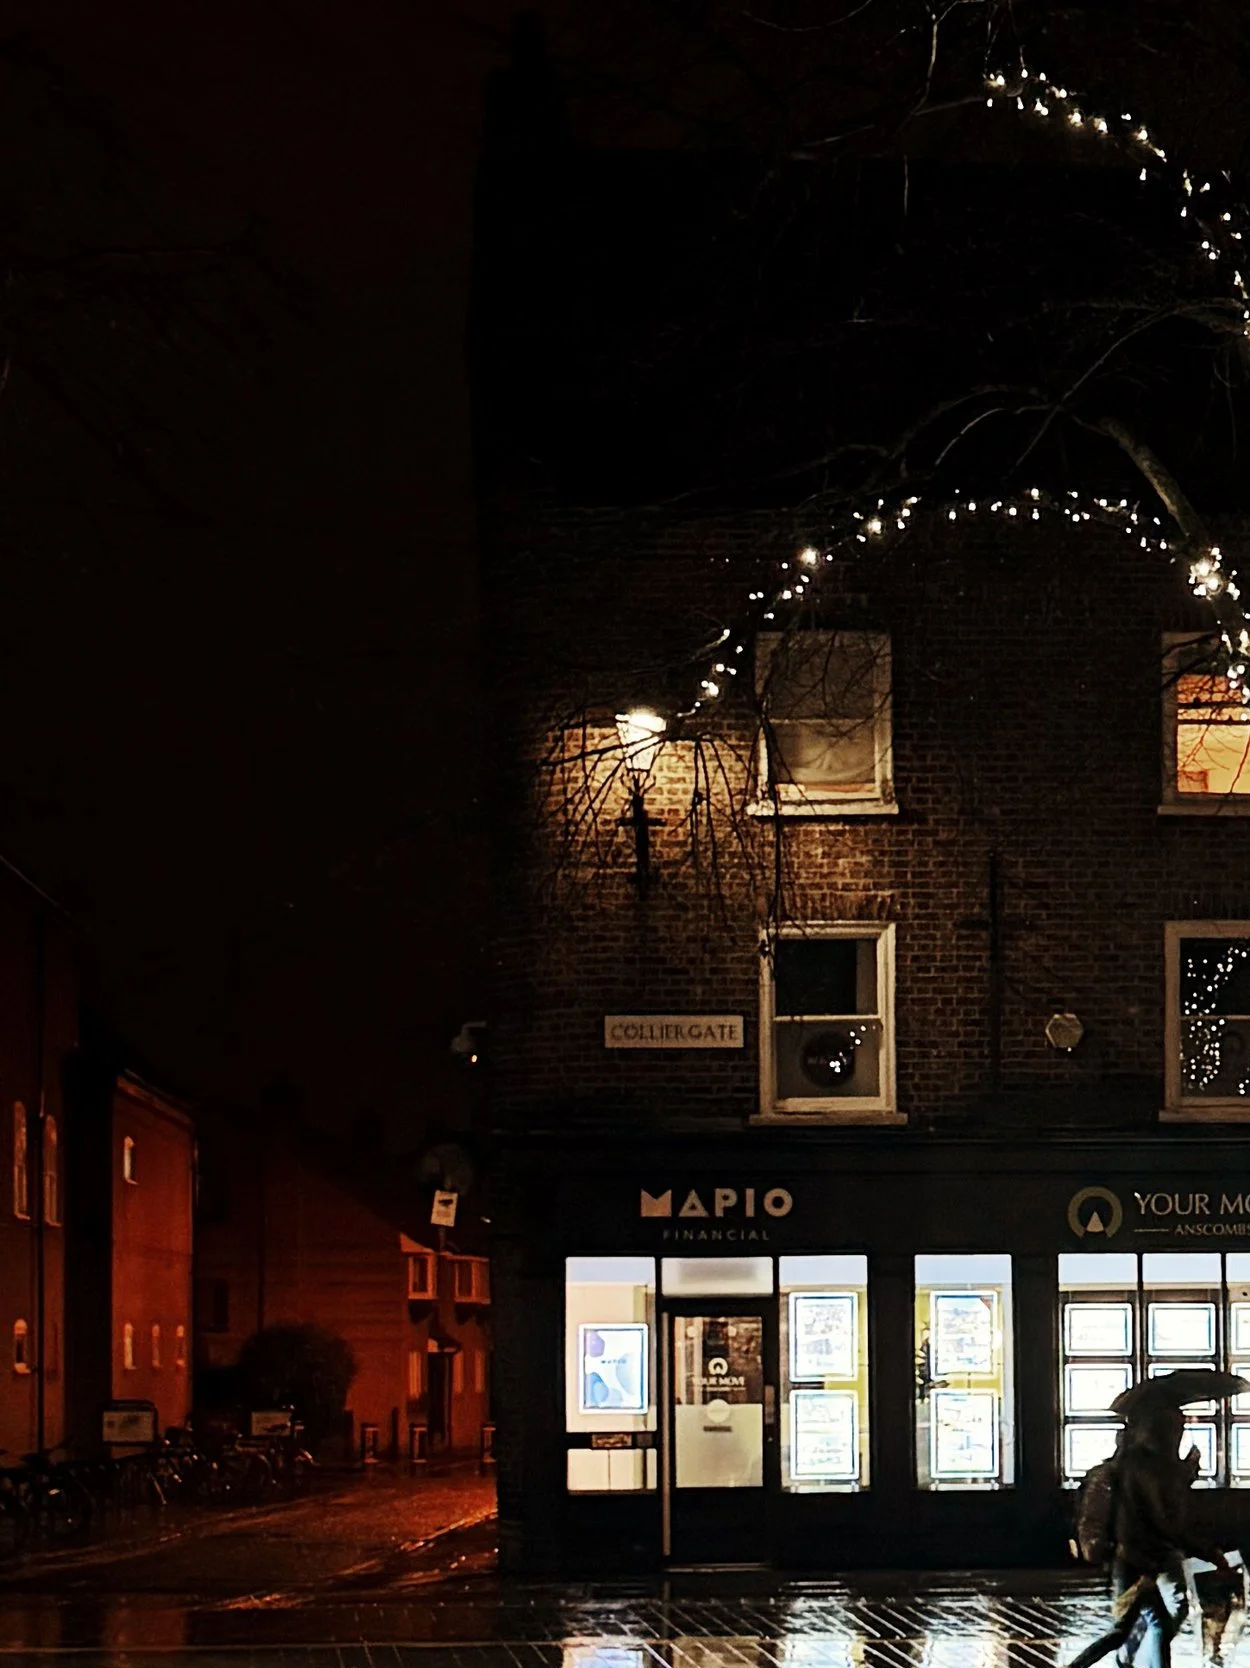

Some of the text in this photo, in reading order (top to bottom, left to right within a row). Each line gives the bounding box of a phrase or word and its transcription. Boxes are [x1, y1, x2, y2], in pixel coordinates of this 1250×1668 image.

[610, 1023, 738, 1041] COLLIERGATE
[640, 1187, 794, 1218] MAPIO
[1133, 1191, 1211, 1216] YOUR
[662, 1229, 770, 1241] FINANCIAL
